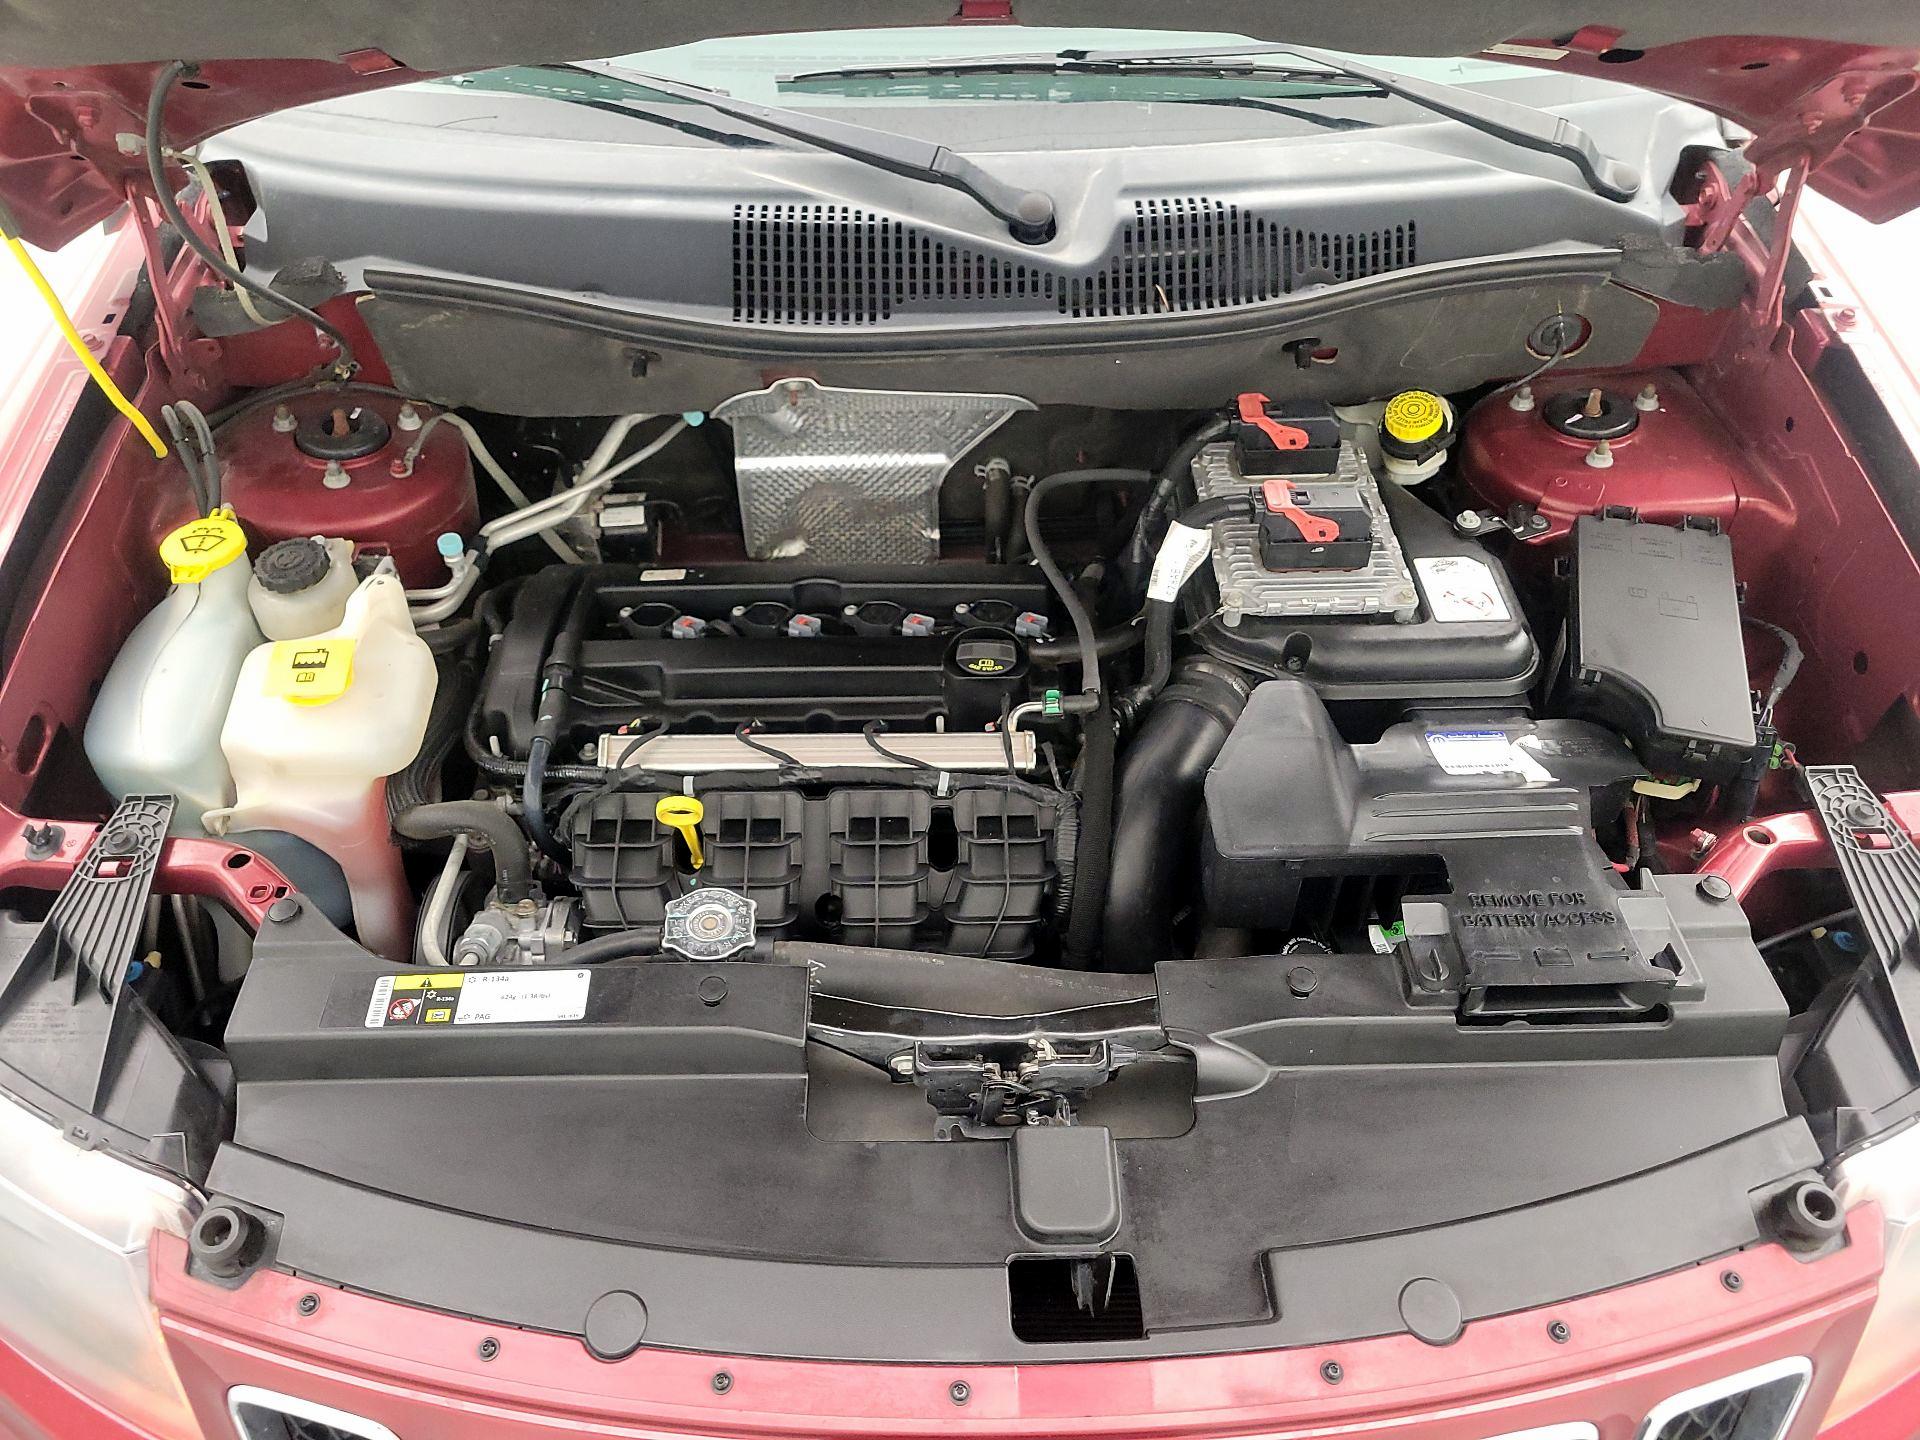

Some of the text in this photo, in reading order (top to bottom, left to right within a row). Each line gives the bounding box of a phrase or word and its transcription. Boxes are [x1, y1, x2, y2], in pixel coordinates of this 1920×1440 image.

[1469, 891, 1587, 908] REMOVE FOR
[1461, 910, 1617, 928] BATTERY ACCESS
